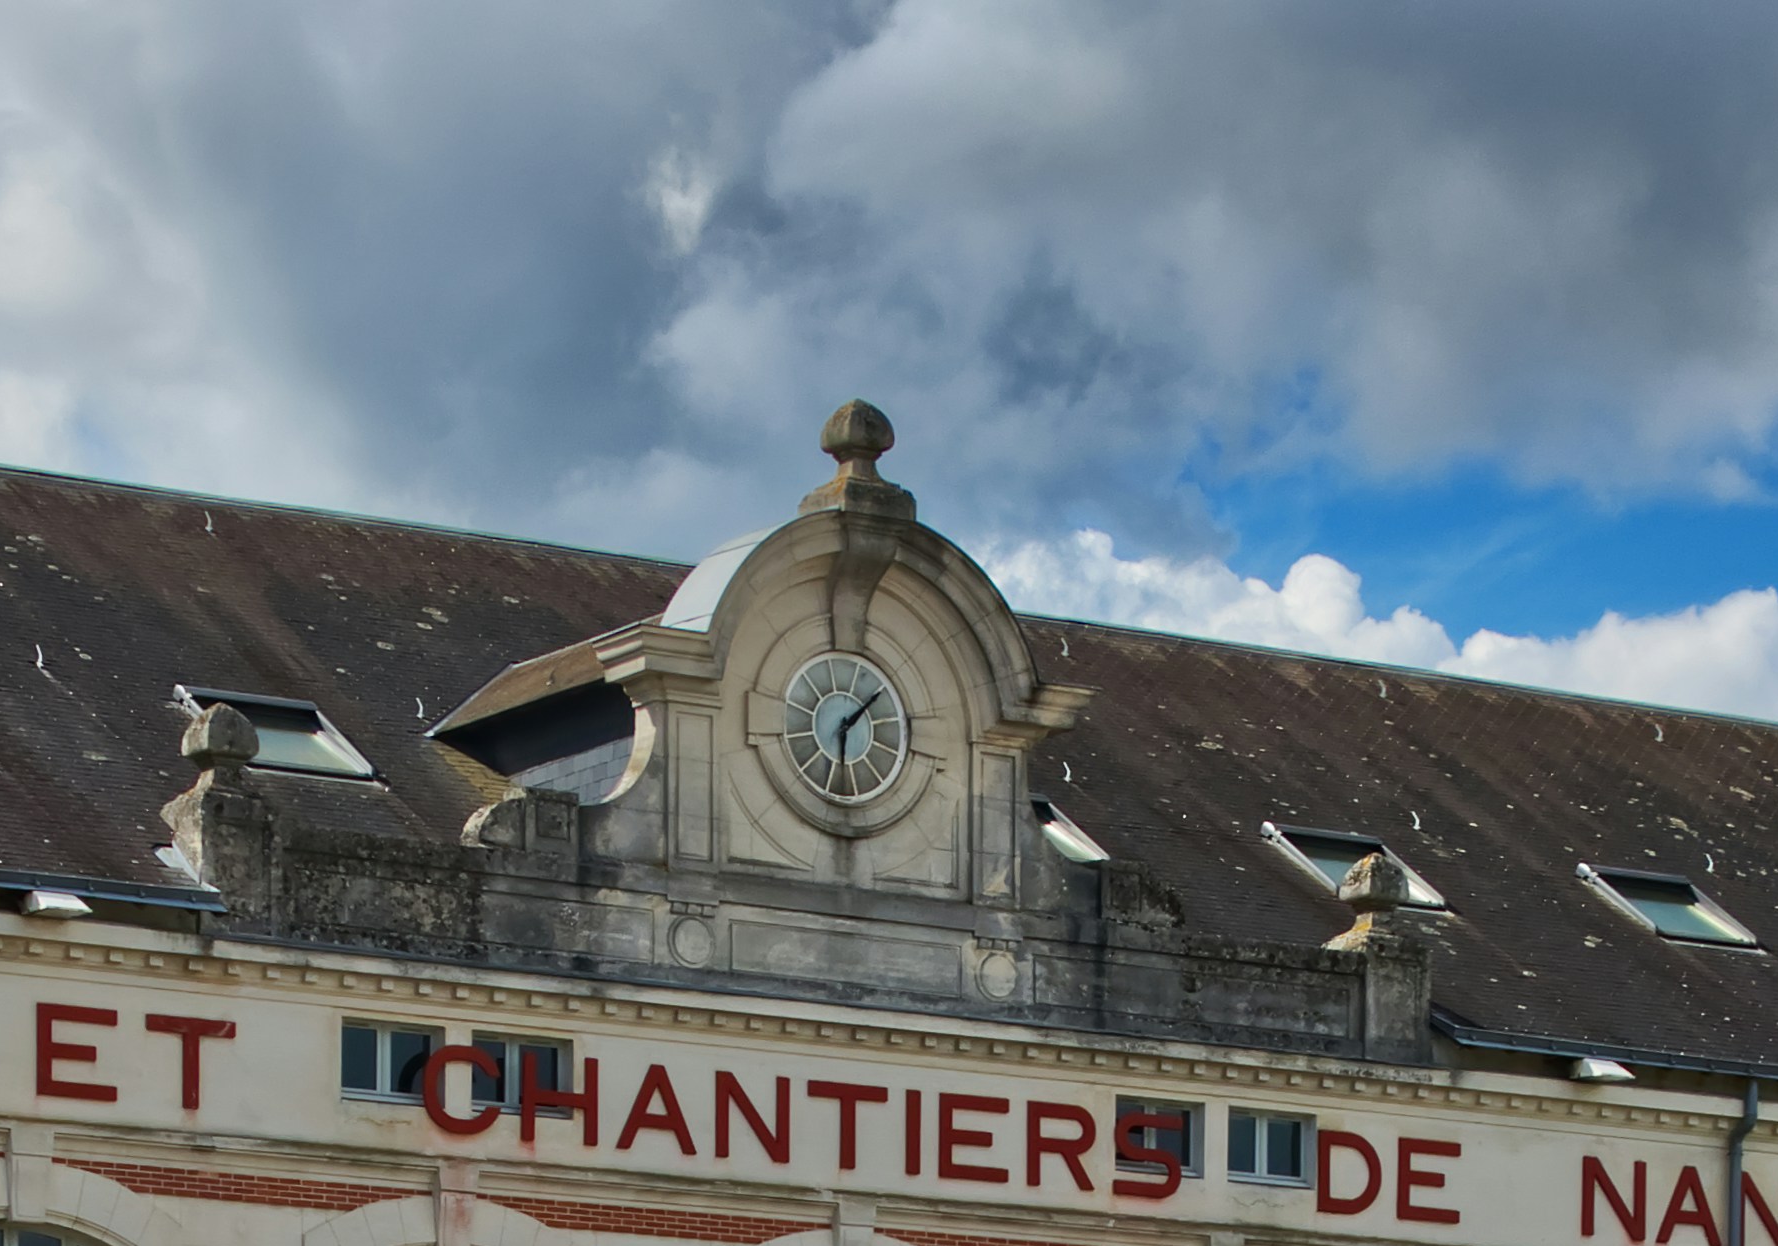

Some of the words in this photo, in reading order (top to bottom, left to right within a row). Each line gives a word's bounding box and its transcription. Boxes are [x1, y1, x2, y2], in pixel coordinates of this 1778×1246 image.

[35, 1003, 236, 1109] ET
[424, 1045, 1183, 1200] CHANTIERS
[1316, 1130, 1461, 1224] DE
